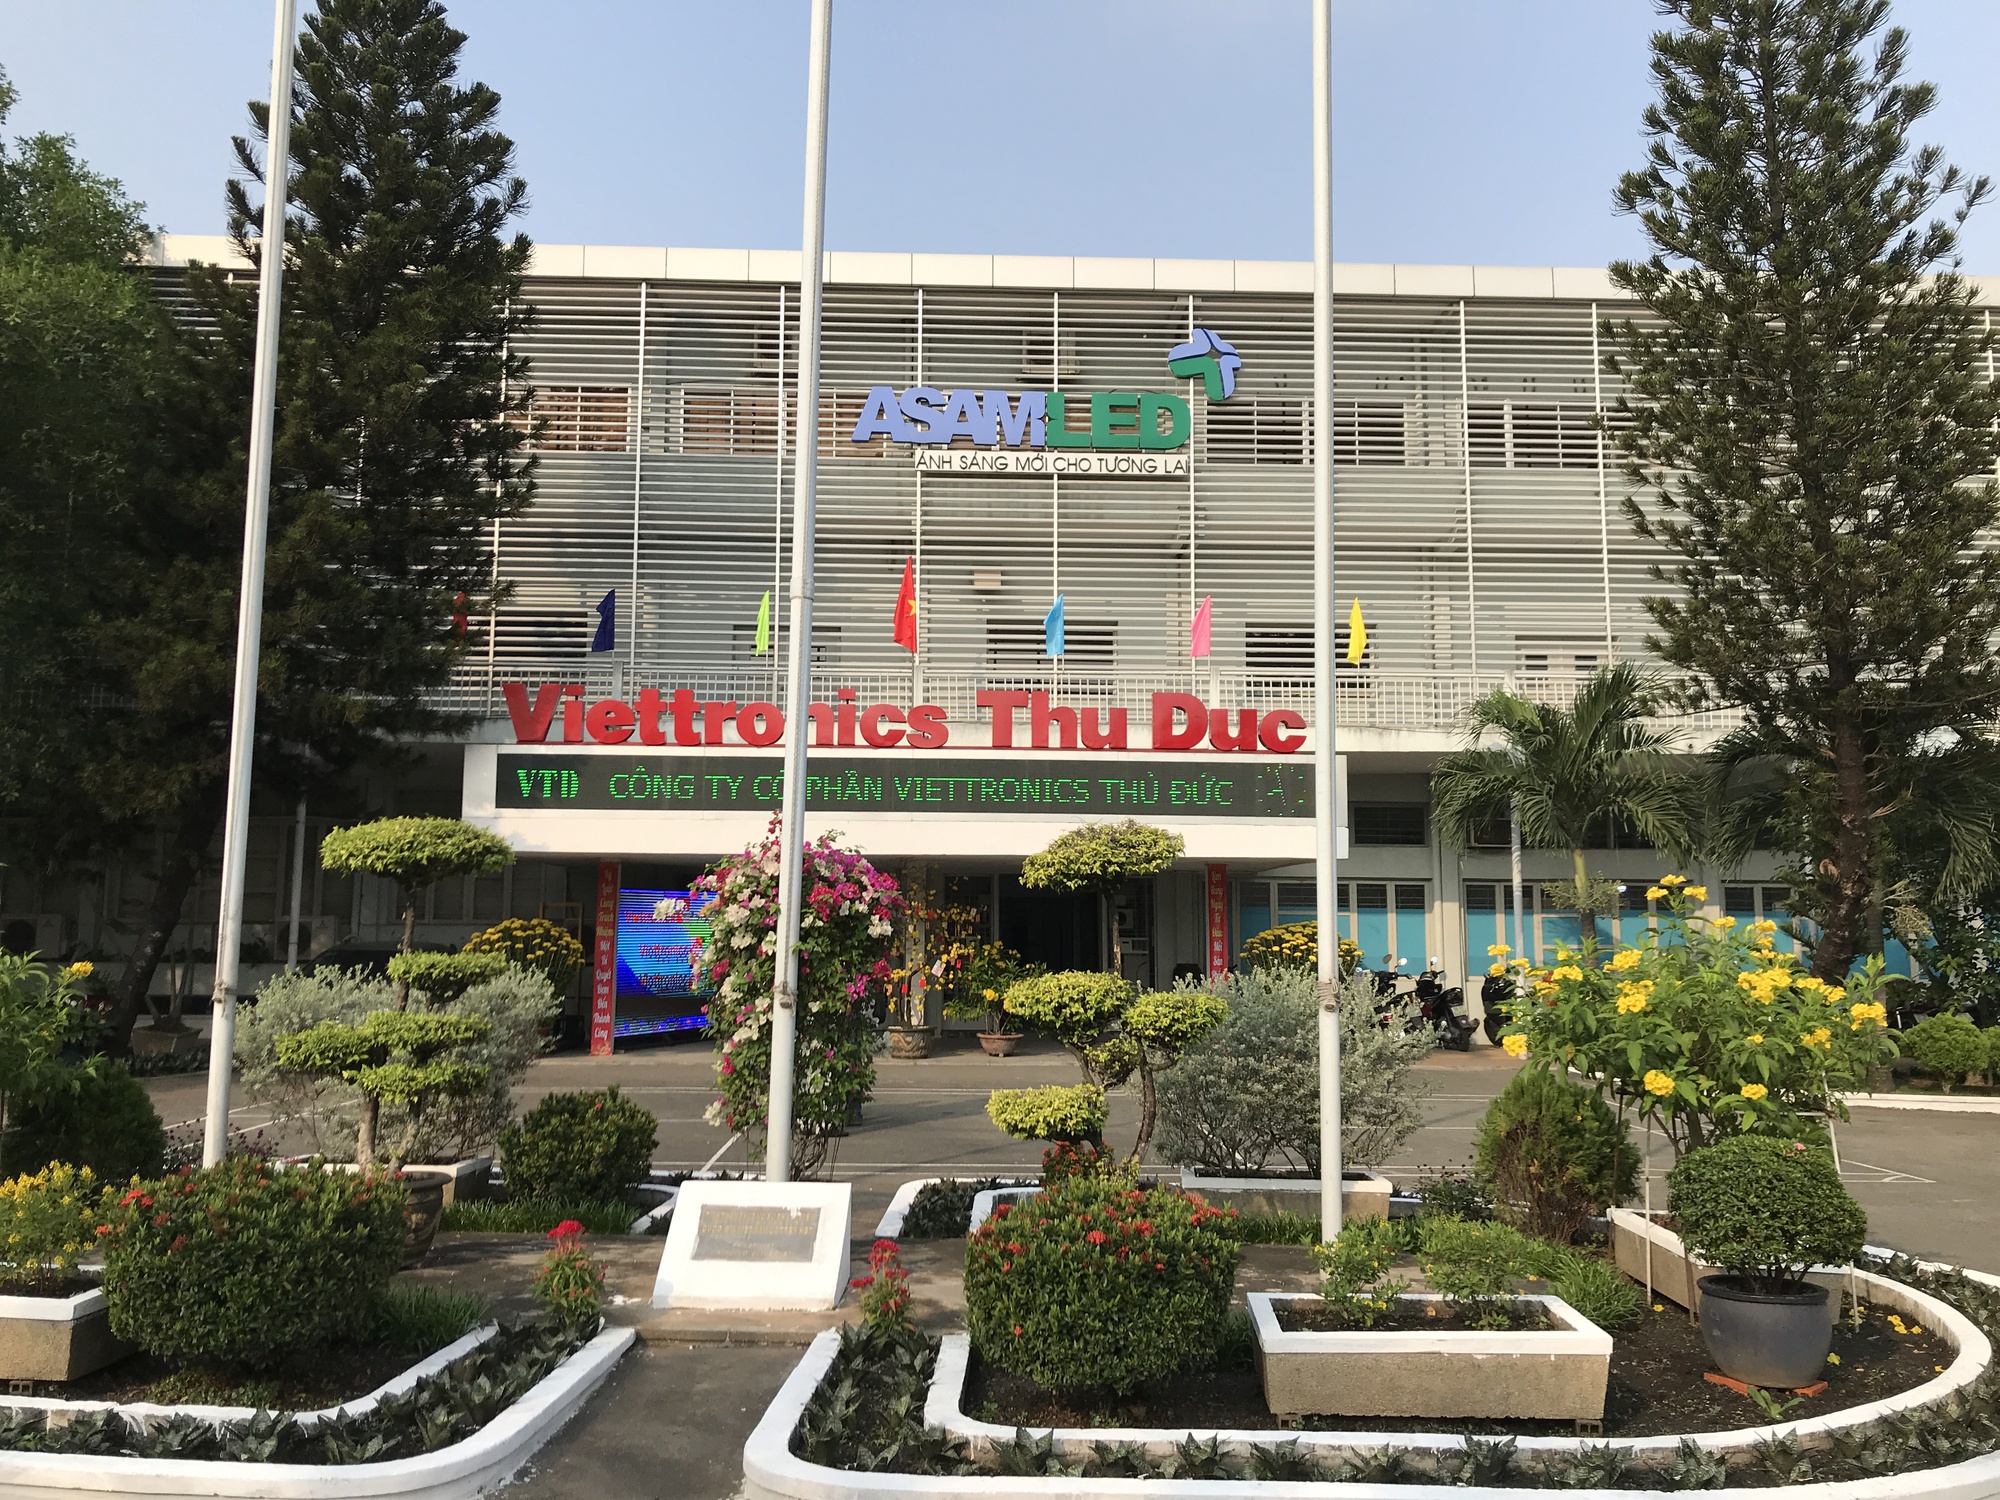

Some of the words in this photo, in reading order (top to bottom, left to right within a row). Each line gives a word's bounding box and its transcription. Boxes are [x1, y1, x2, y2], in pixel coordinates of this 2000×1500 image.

[916, 451, 952, 469] ÁNH
[959, 451, 1008, 470] SÁNG
[1016, 453, 1048, 472] MỚI
[1053, 457, 1092, 472] CHO
[1097, 456, 1158, 473] TƯƠNG
[1164, 459, 1188, 473] LAI
[503, 683, 949, 749] Viettronics
[976, 690, 1127, 749] Thu
[1152, 692, 1307, 752] Duc
[517, 769, 579, 798] VTD
[609, 765, 695, 799] CÔNG
[704, 775, 744, 800] TY
[806, 770, 882, 801] PHẦN
[894, 777, 1090, 803] VIETTRONICS
[1169, 772, 1234, 805] ĐỨC
